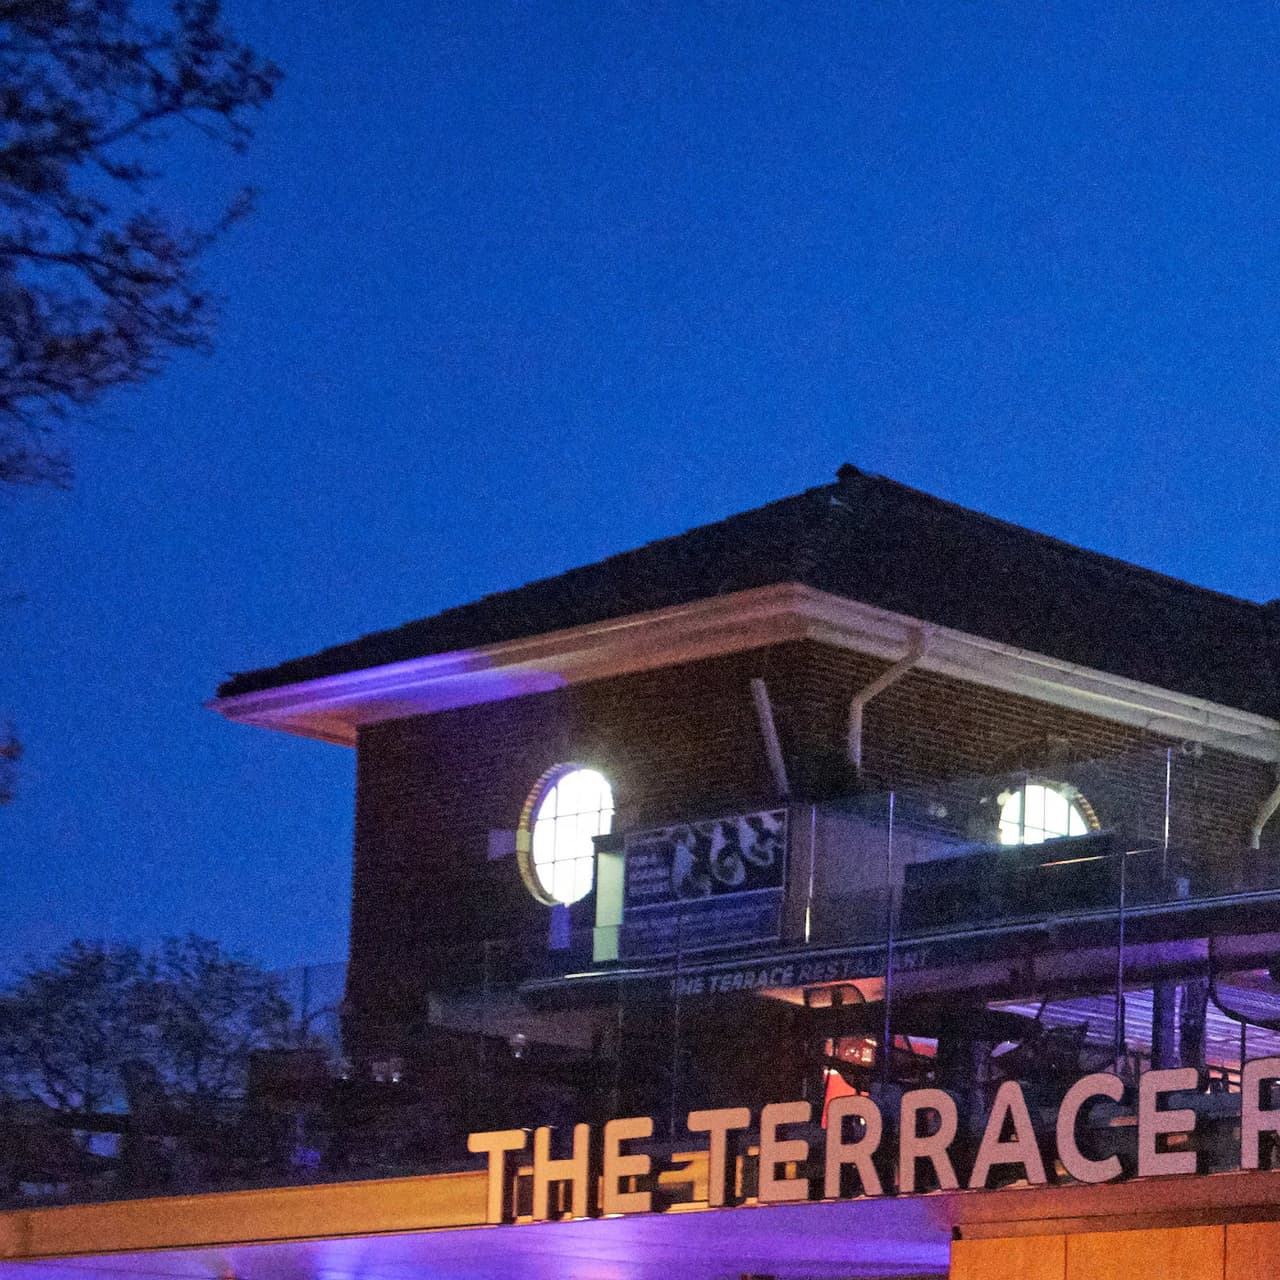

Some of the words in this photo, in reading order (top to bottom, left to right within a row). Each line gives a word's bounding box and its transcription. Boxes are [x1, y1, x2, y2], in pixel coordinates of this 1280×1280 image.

[710, 965, 794, 992] TERRACE
[467, 1116, 653, 1225] THE
[687, 1067, 1199, 1206] TERRACE
